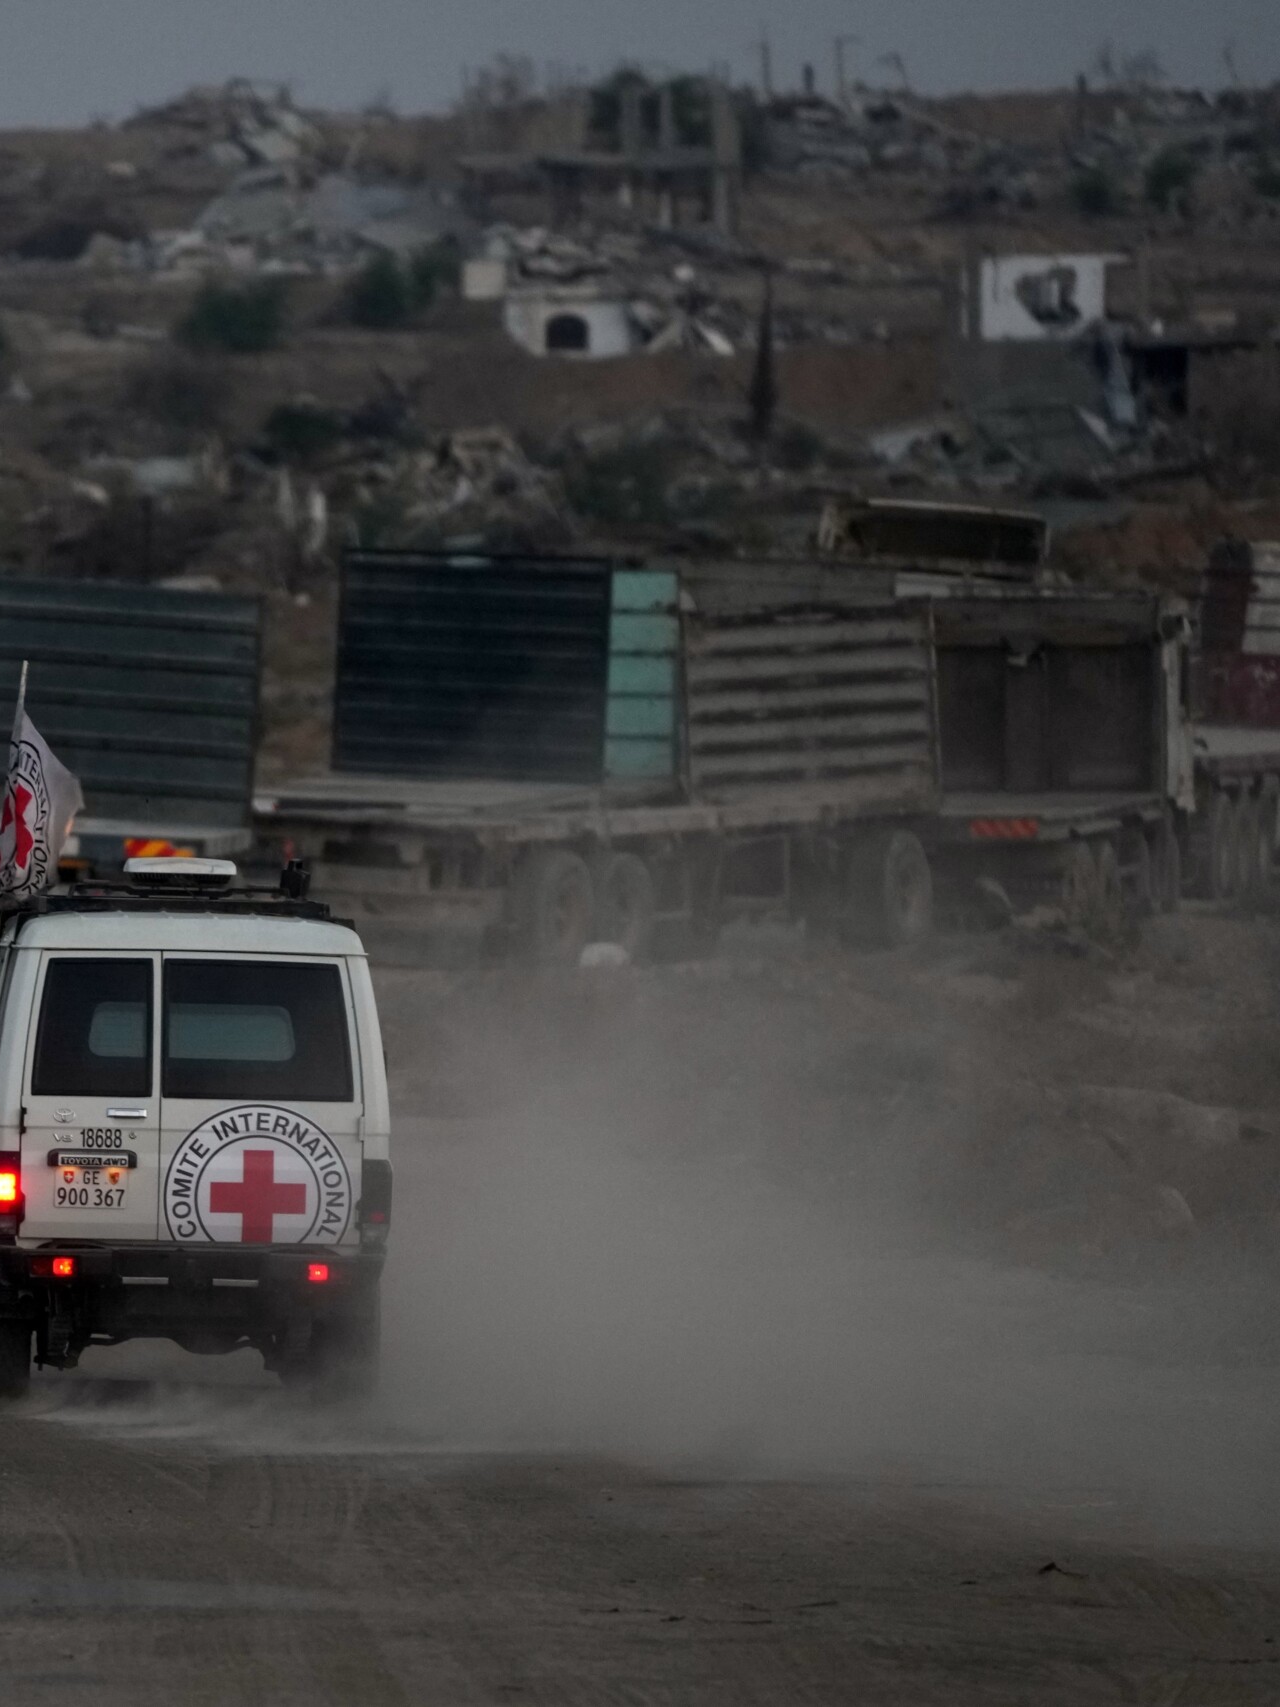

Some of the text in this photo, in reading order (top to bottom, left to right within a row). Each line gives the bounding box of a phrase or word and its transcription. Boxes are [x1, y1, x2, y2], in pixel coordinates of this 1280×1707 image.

[80, 1128, 123, 1148] 18688
[62, 1157, 128, 1166] TOYOTA 4WD
[83, 1170, 100, 1185] GE
[172, 1112, 345, 1238] COMITE INTERNATIONAL
[57, 1187, 125, 1207] 900 367
